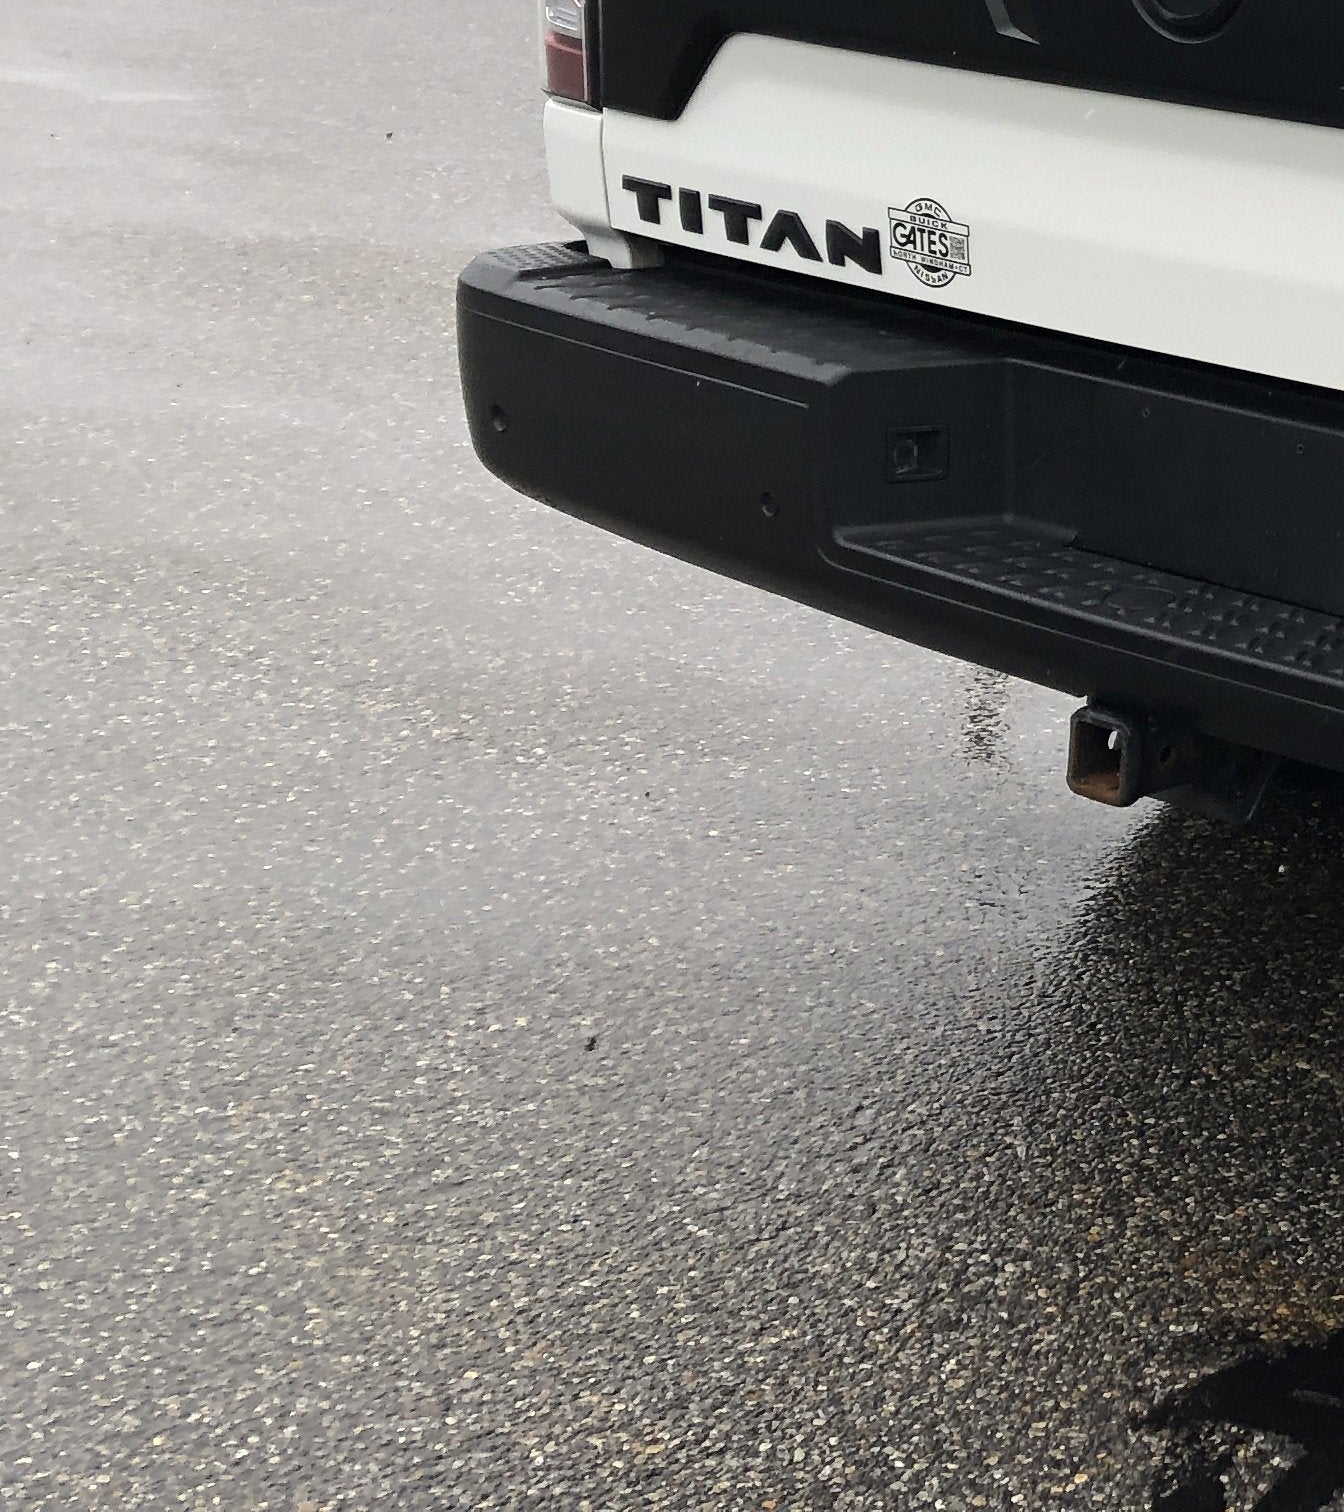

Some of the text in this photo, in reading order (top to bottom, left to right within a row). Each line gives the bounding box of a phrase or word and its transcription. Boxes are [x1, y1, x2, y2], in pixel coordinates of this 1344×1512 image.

[914, 202, 942, 218] GMC
[621, 174, 883, 276] TITAN
[909, 215, 949, 230] BUICK
[893, 222, 949, 258] GATES
[913, 264, 949, 284] NISSAN
